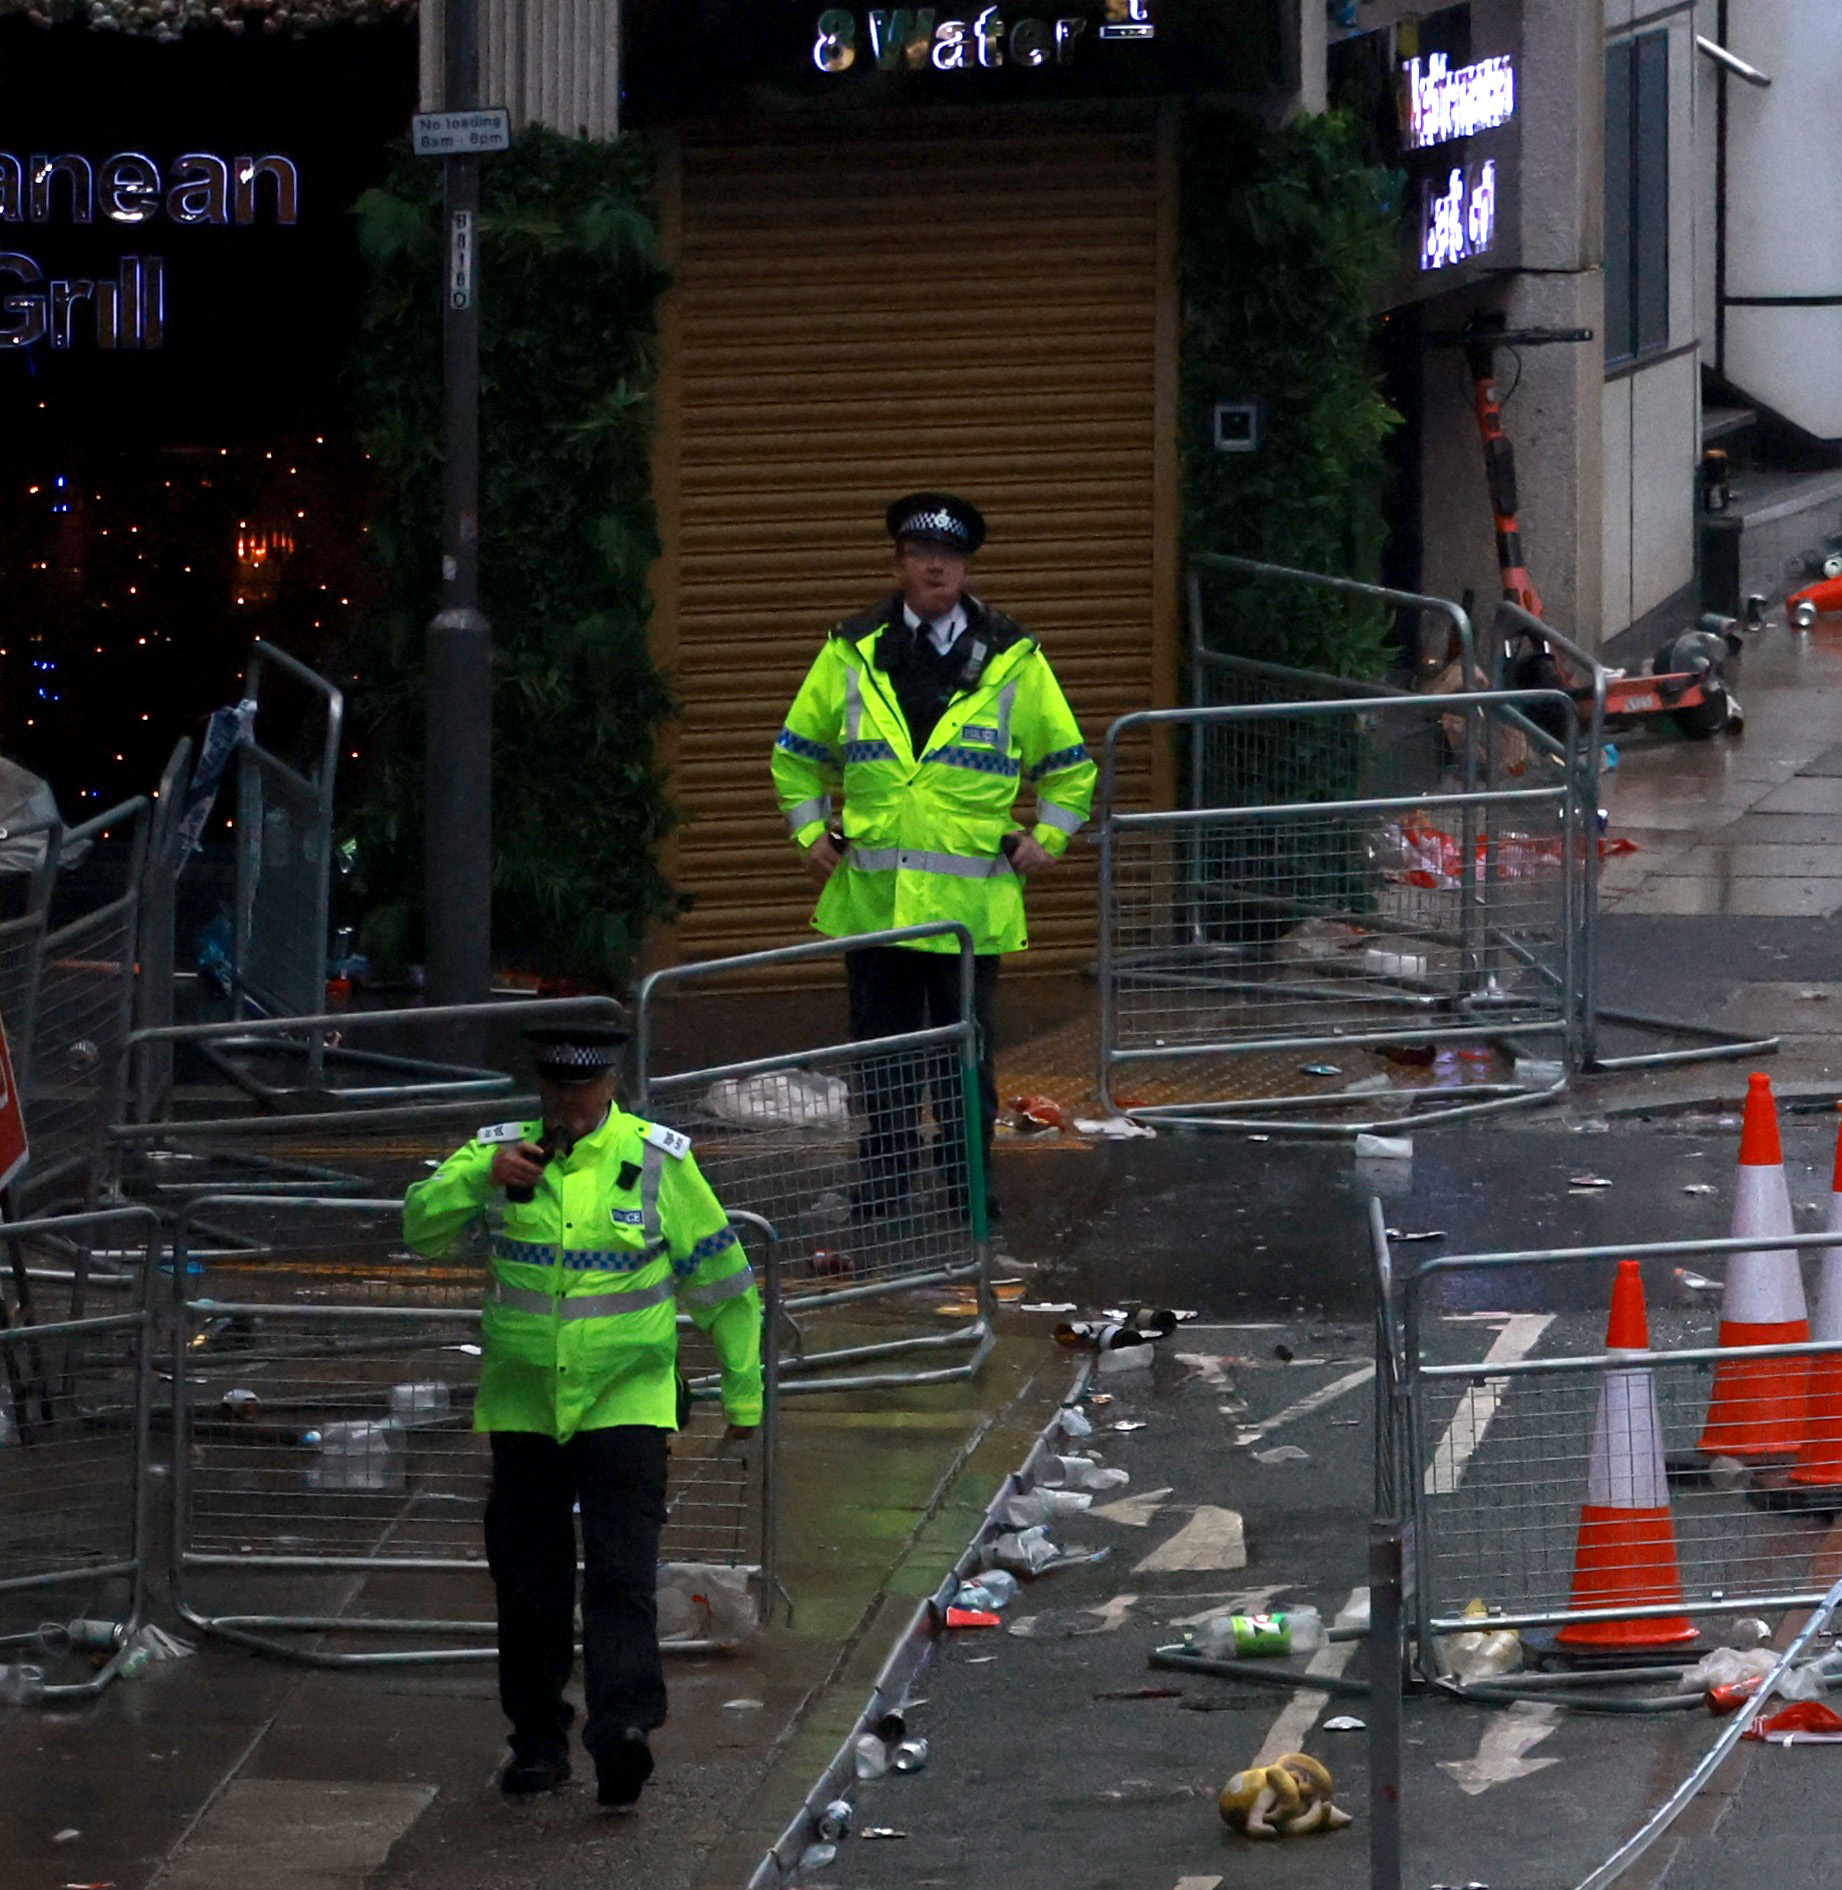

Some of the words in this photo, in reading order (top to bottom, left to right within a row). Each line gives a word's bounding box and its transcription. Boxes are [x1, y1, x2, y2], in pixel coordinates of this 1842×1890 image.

[812, 8, 856, 72] 8
[868, 5, 1086, 70] Water
[420, 119, 440, 130] No
